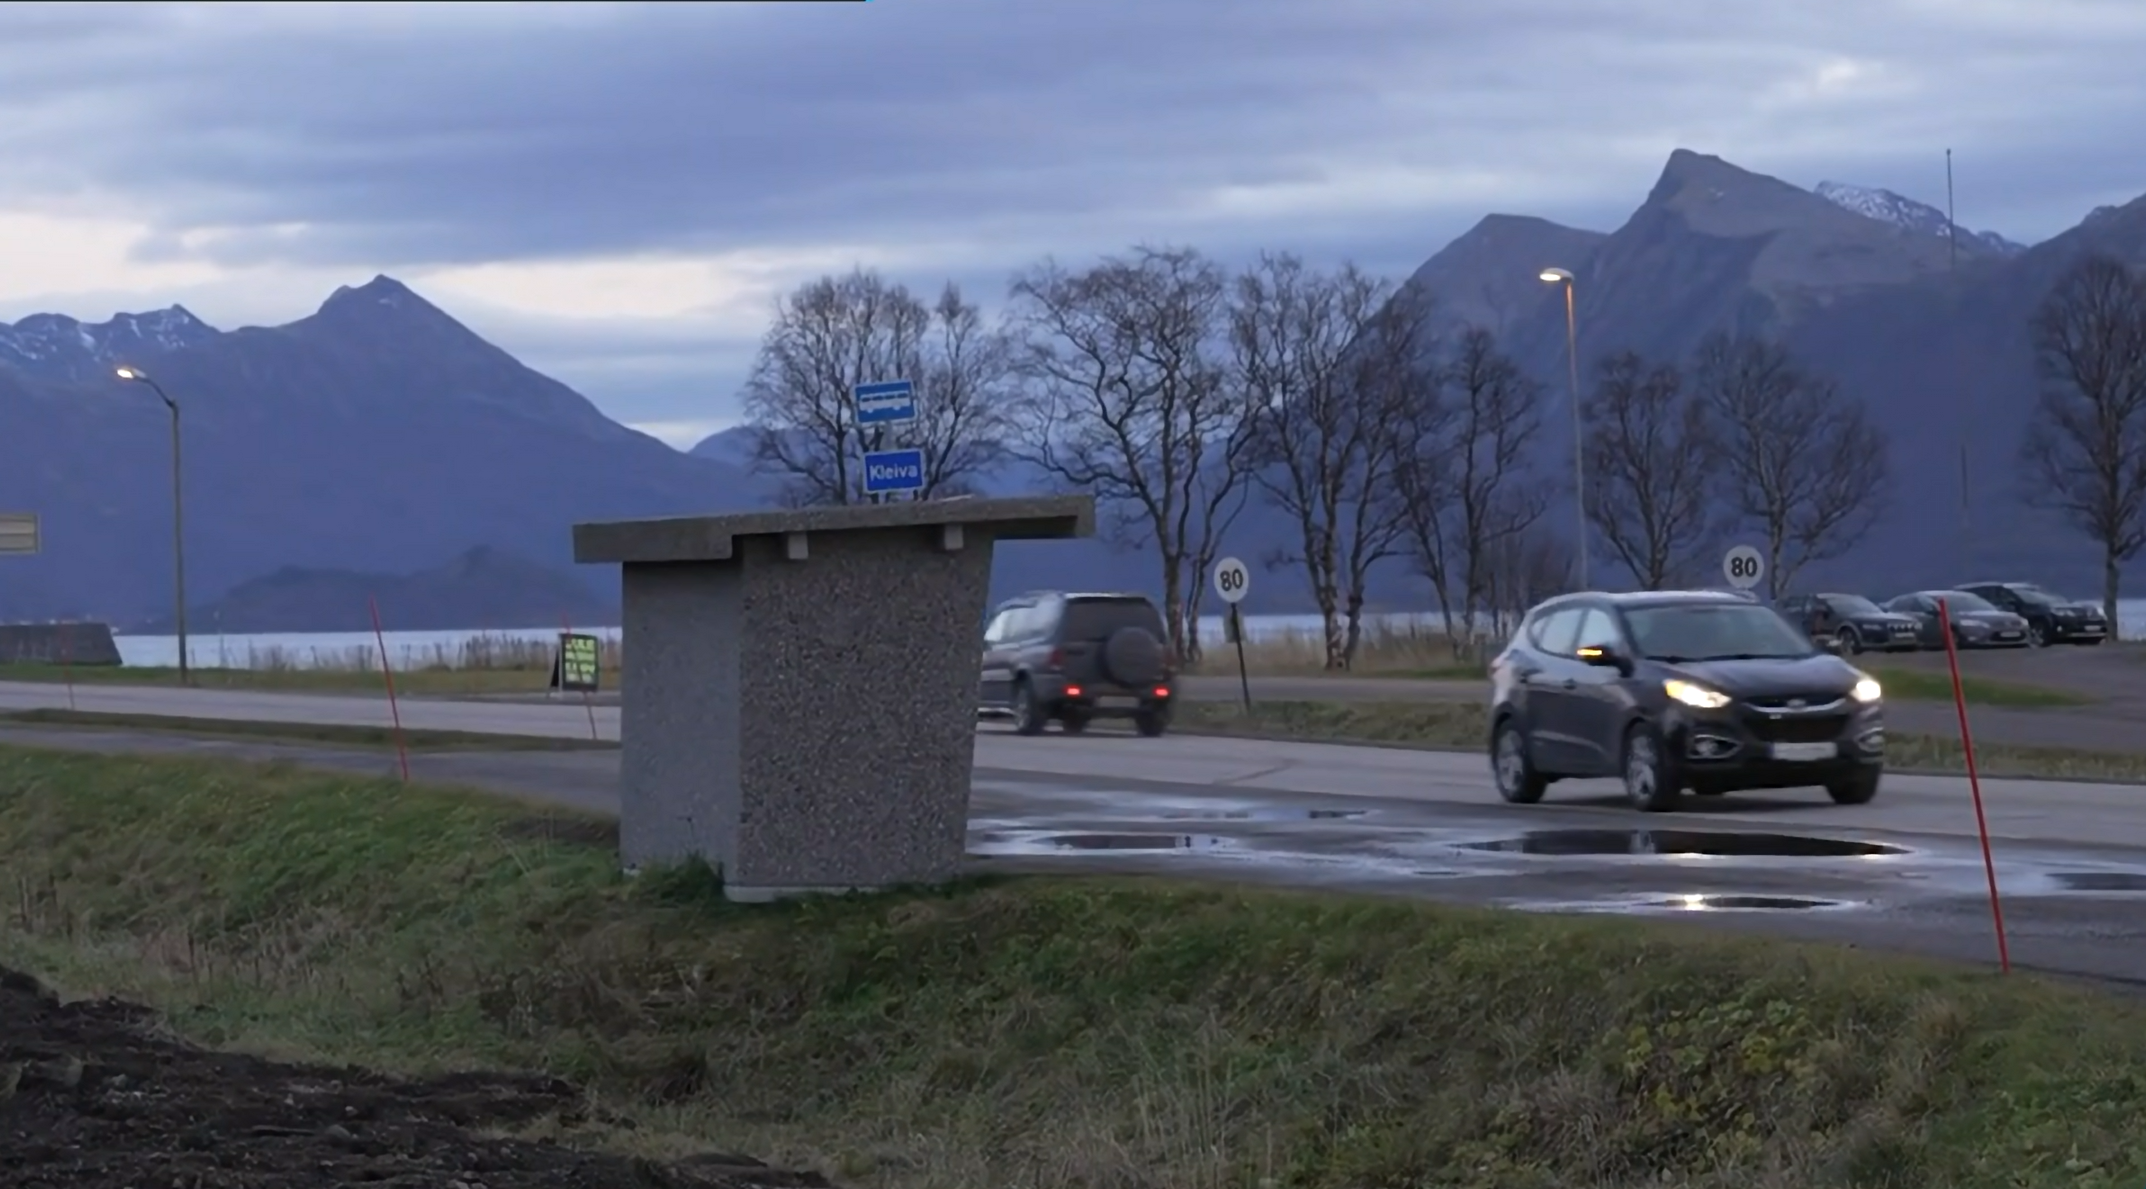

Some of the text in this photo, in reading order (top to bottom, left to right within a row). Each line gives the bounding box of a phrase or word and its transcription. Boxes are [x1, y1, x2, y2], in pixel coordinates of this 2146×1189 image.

[869, 463, 918, 482] Kleiva
[1730, 555, 1758, 578] 80
[1219, 568, 1244, 593] 80
